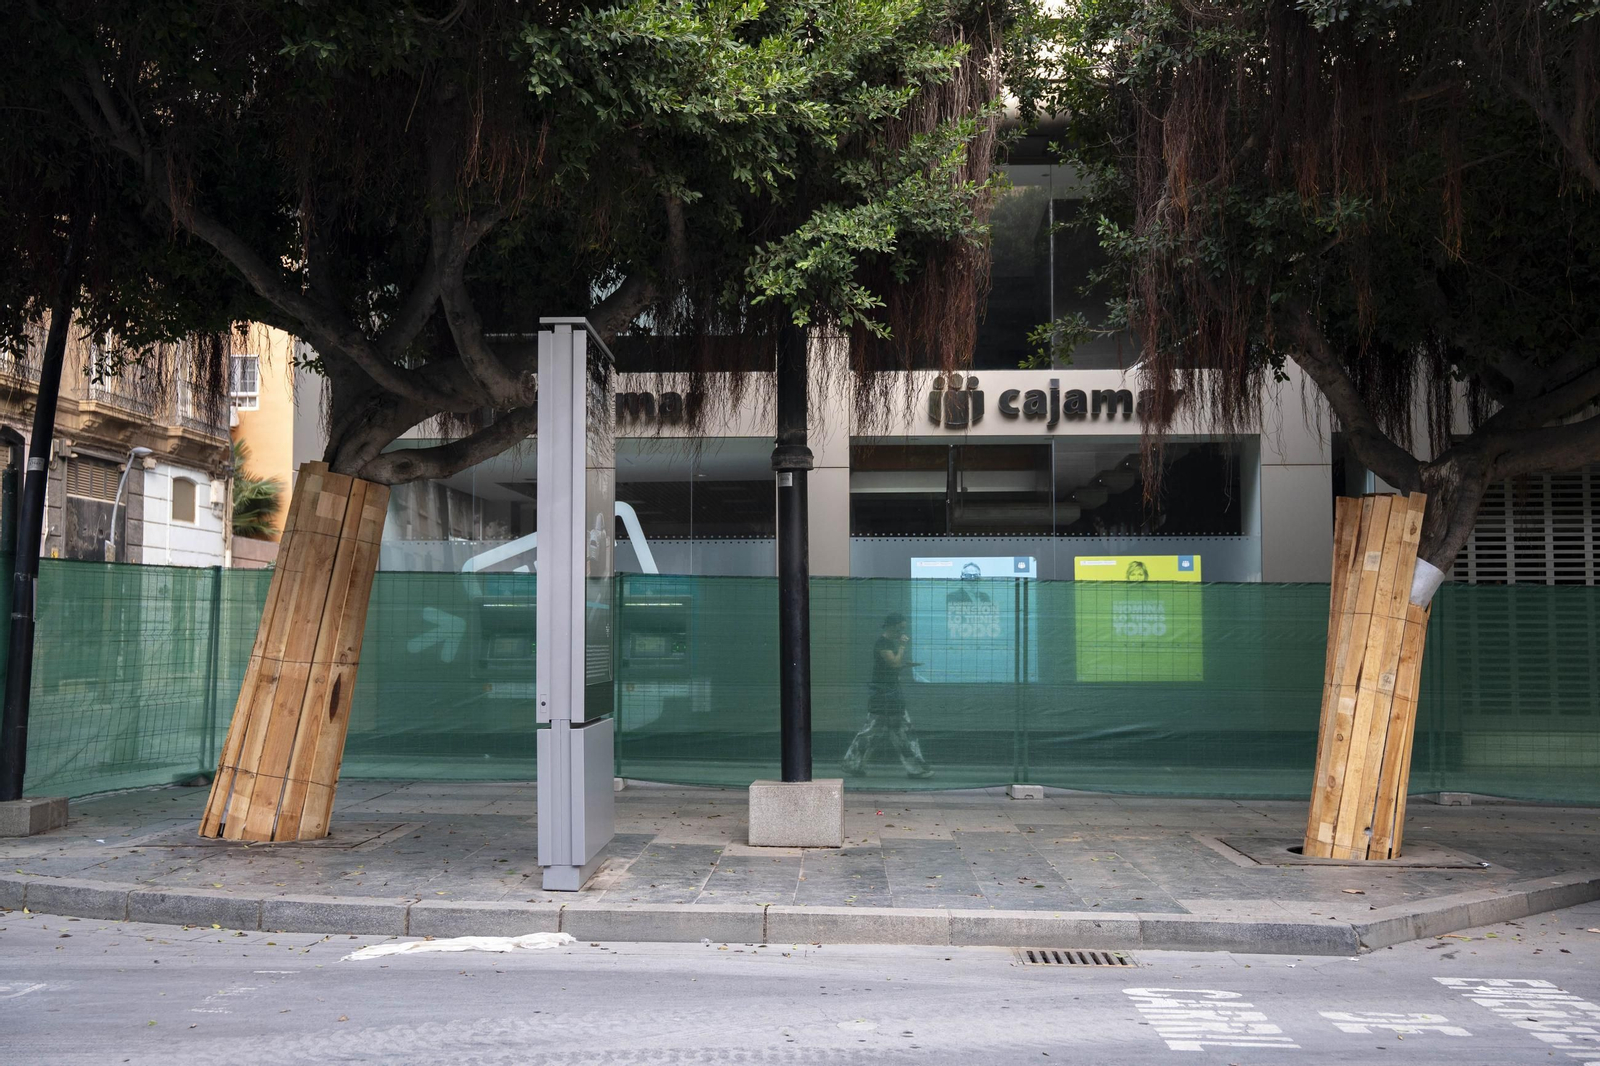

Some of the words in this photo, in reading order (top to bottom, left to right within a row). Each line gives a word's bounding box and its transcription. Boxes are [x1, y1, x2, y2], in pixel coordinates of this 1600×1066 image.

[948, 623, 1001, 638] TODO
[1113, 622, 1167, 637] TODO
[1122, 987, 1301, 1051] CARRIL
[1317, 1011, 1473, 1036] DE
